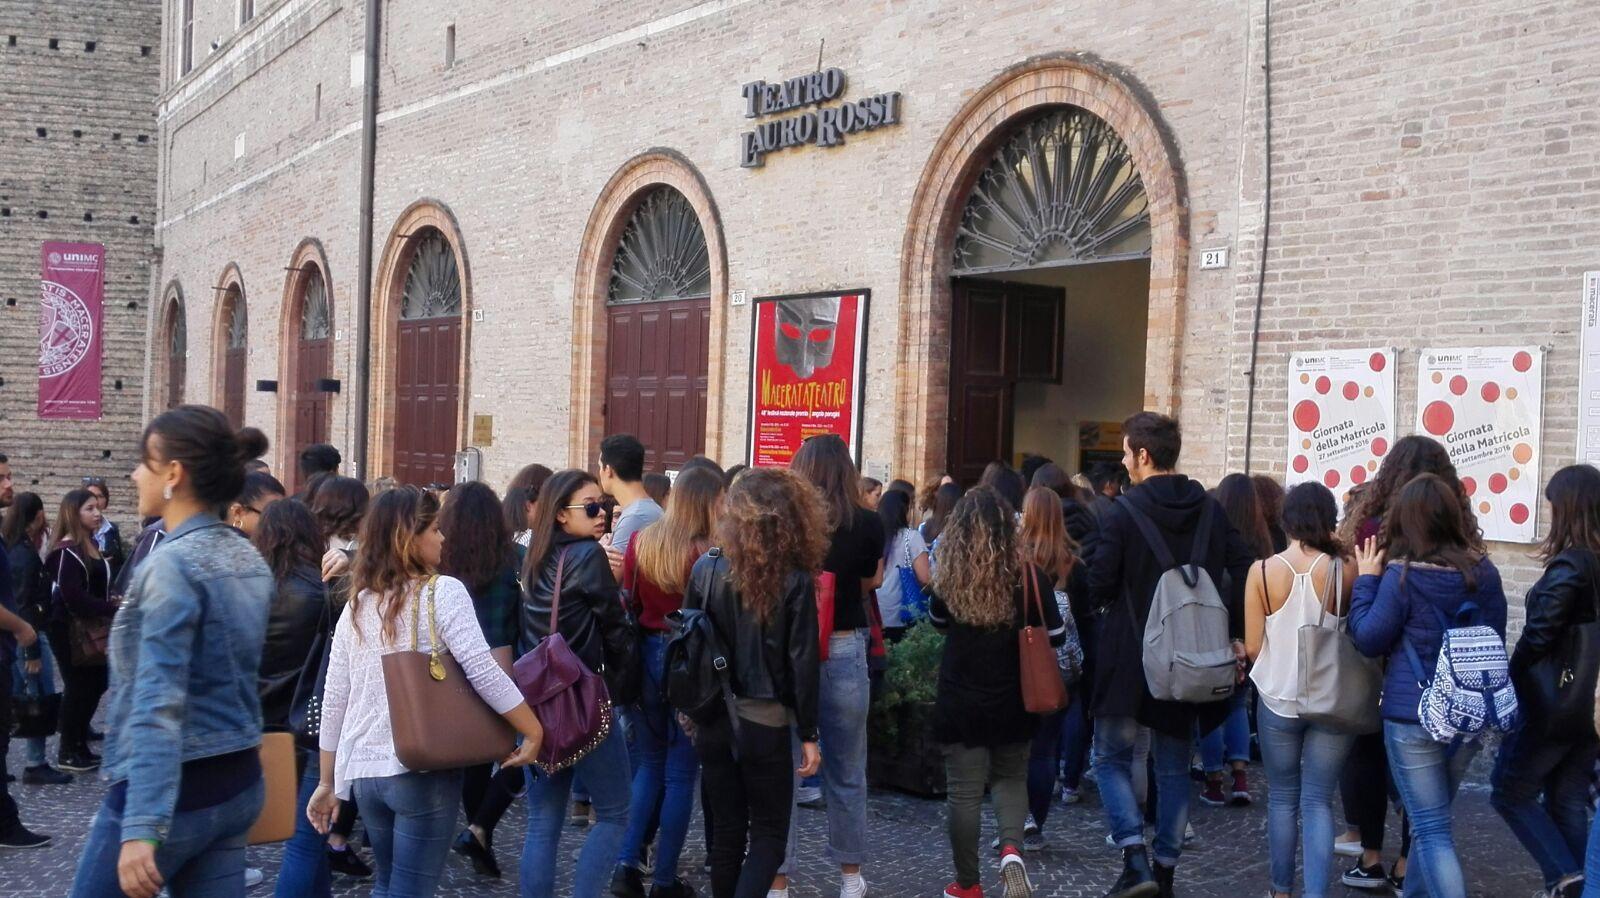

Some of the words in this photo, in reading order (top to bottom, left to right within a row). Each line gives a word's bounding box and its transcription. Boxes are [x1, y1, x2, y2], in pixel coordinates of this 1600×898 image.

[742, 67, 847, 118] TEATRO
[740, 112, 816, 167] LAURO
[815, 91, 901, 147] ROSSI
[1206, 252, 1219, 265] 21
[1313, 419, 1354, 440] Giornata
[1316, 438, 1339, 452] della
[1340, 422, 1386, 444] Matricola
[1446, 423, 1494, 444] Giornata
[1318, 453, 1326, 461] 27
[1327, 445, 1354, 458] settembre
[1355, 439, 1370, 449] 2016
[1449, 442, 1475, 457] della
[1477, 426, 1530, 450] Matricola
[1461, 451, 1493, 464] settembre
[1494, 445, 1511, 454] 2016
